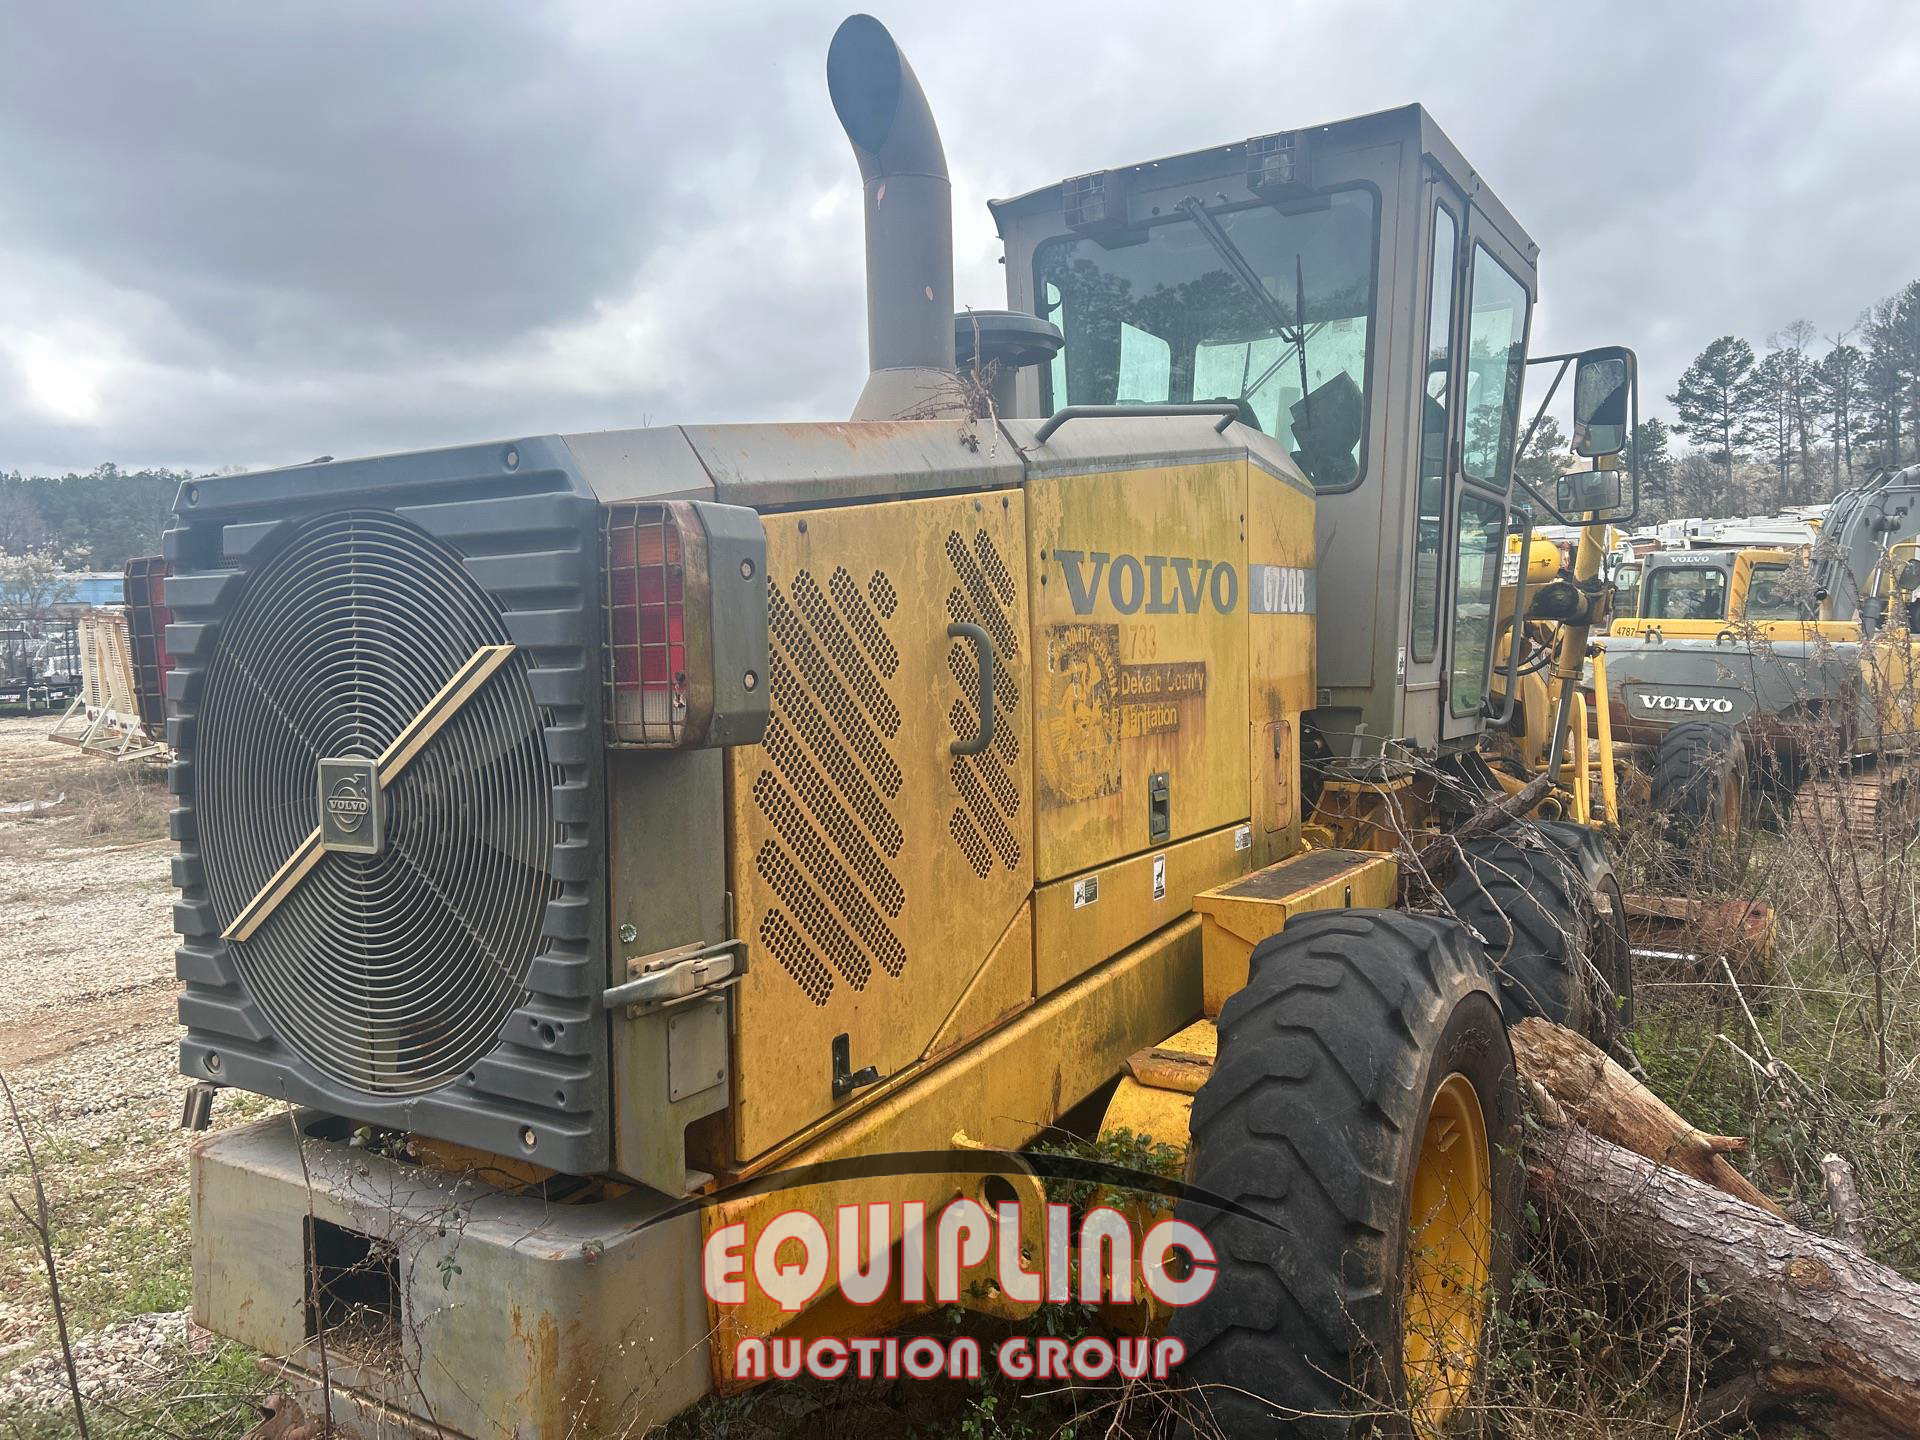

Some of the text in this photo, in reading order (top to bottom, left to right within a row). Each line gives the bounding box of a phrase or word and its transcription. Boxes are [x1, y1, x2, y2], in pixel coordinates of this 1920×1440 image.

[1670, 555, 1709, 563] VOLVO
[1054, 549, 1238, 615] VOLVO
[1263, 566, 1305, 612] G720B
[1616, 626, 1636, 637] 4787
[1639, 694, 1733, 713] VOLVO
[1123, 705, 1178, 731] anitation
[328, 800, 366, 811] VOLVO
